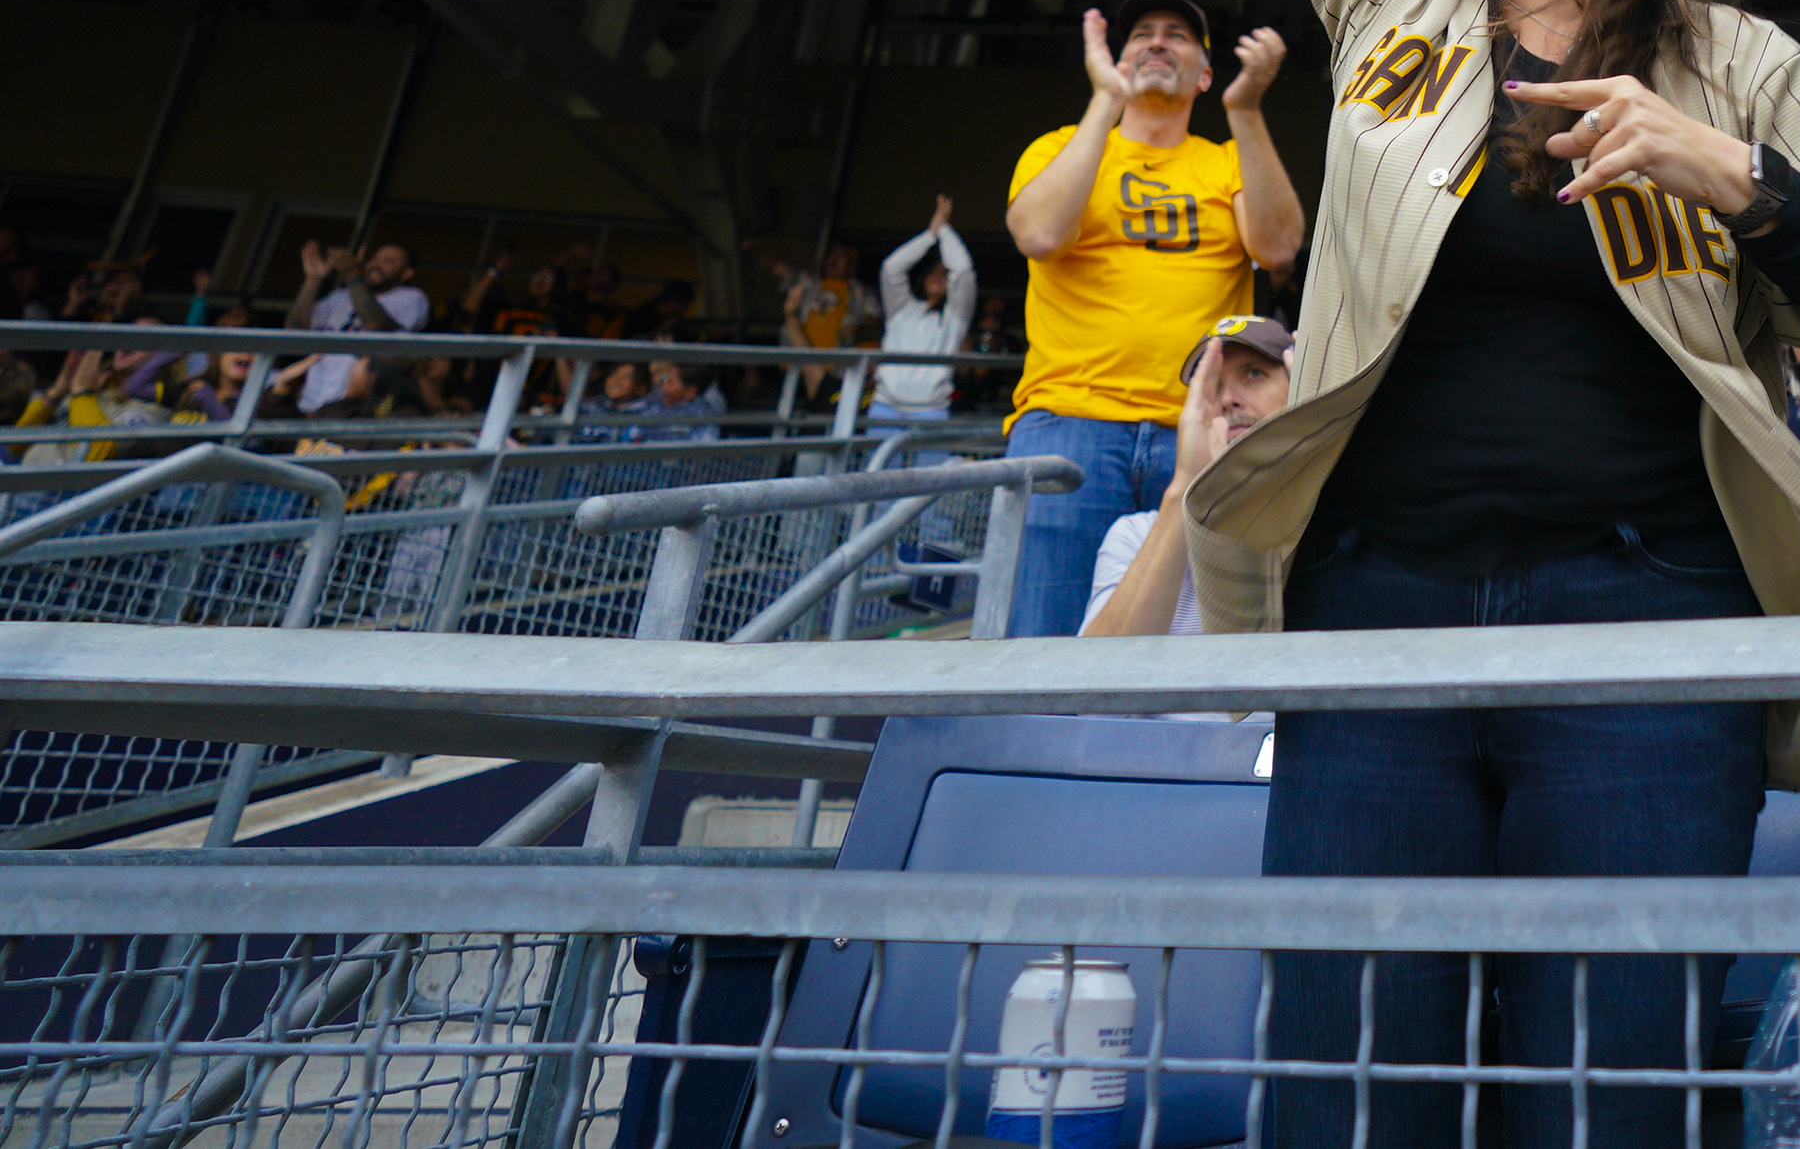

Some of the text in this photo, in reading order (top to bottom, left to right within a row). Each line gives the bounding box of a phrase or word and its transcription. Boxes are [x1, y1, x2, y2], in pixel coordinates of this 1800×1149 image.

[1121, 172, 1200, 254] SD
[1337, 25, 1741, 285] SAN DIE
